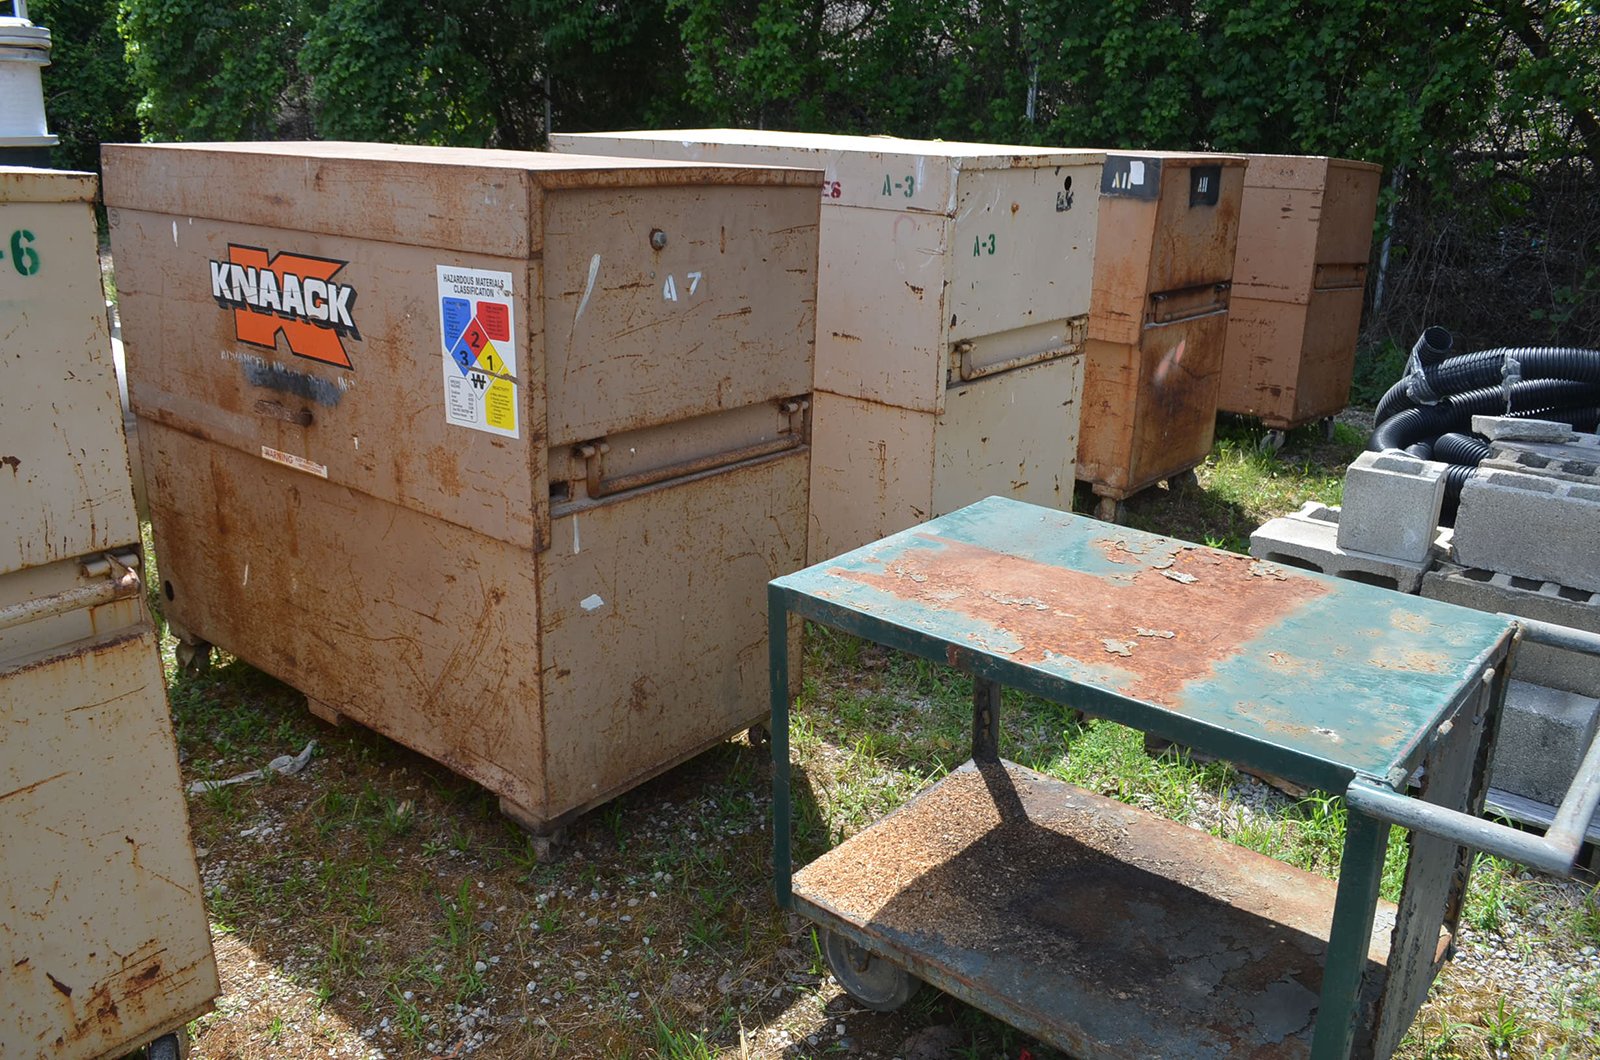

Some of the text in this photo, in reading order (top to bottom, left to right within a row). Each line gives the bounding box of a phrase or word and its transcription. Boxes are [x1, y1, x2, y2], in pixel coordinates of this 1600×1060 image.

[882, 174, 915, 198] A-3
[973, 233, 996, 257] A-3
[443, 273, 505, 289] HAZARDOUS MATERIALS
[209, 260, 357, 330] KNAACK
[453, 285, 495, 298] CLASSIFICATION
[471, 331, 480, 348] 2
[459, 350, 469, 367] 3
[486, 354, 494, 371] 1
